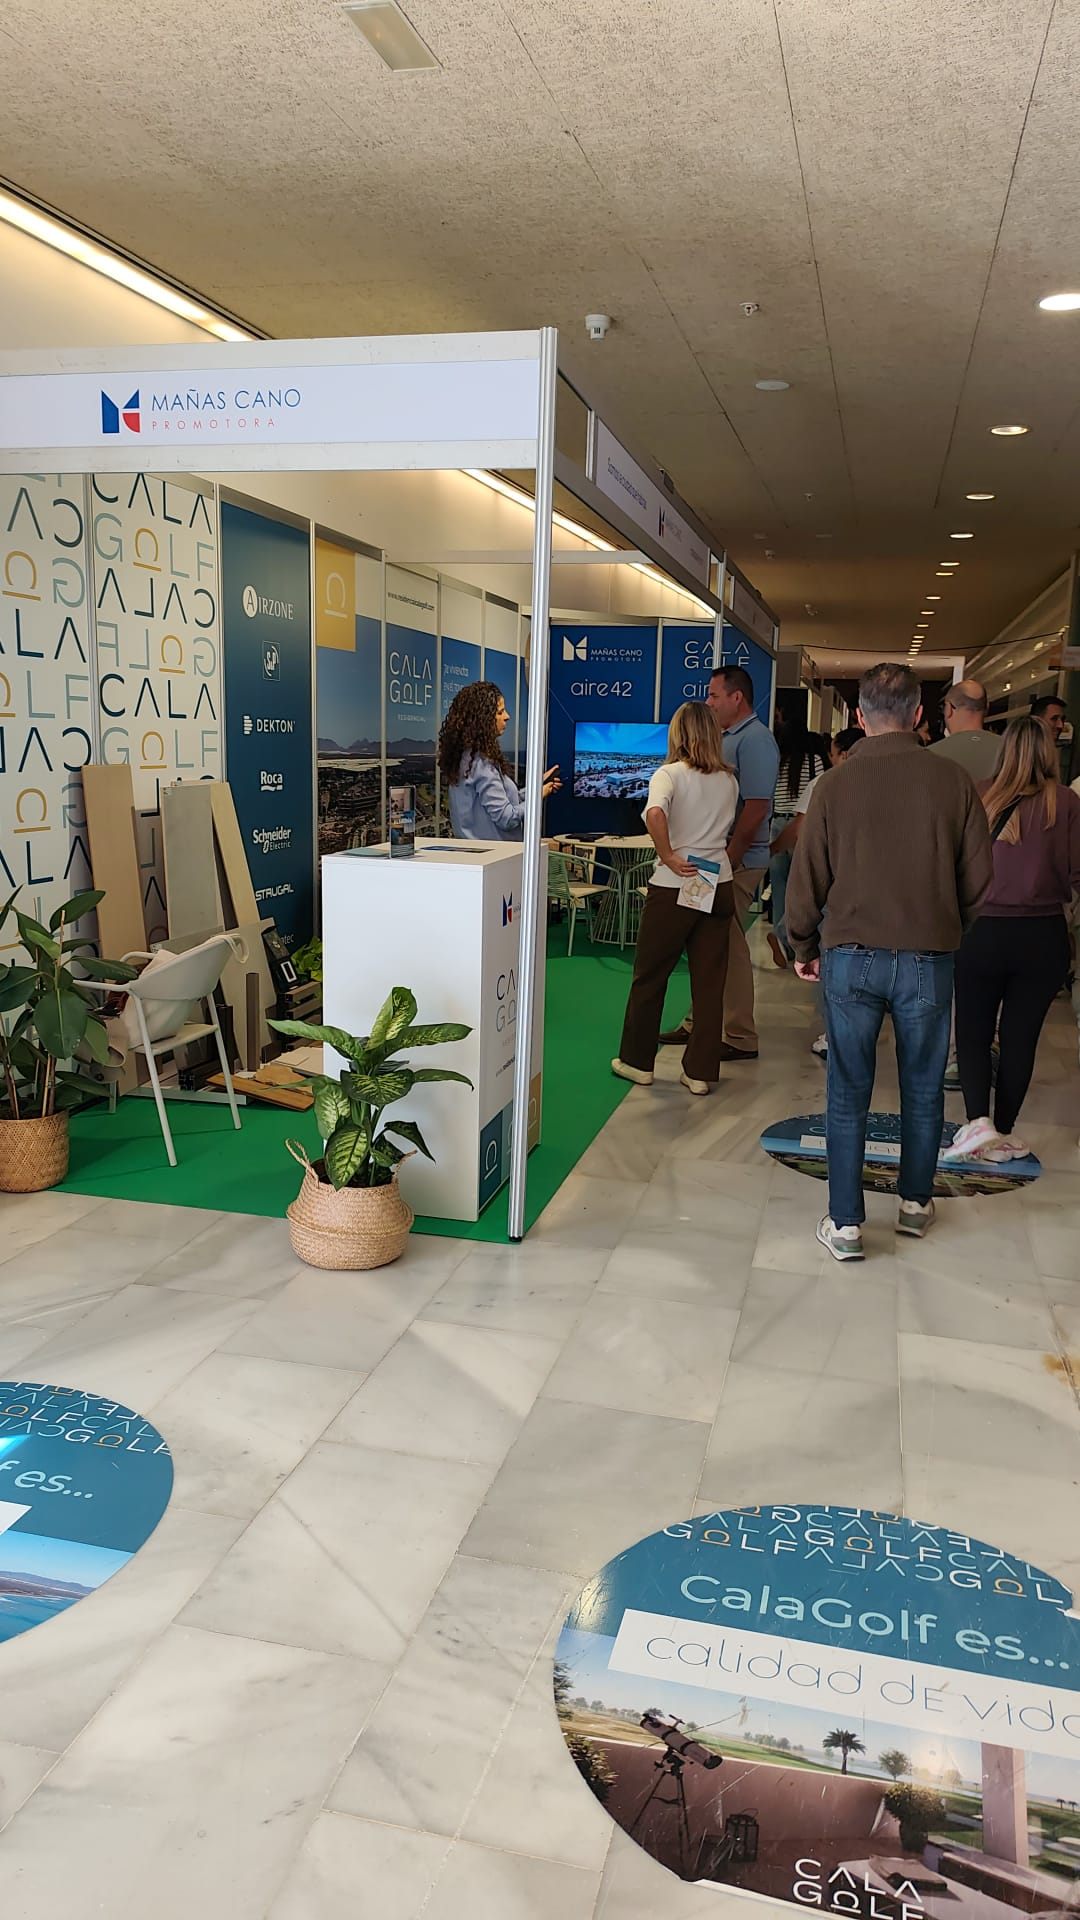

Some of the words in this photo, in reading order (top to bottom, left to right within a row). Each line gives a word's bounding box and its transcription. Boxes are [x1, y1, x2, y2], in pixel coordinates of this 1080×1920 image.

[151, 388, 226, 412] MAÑAS
[234, 388, 301, 409] CANO
[152, 417, 276, 431] PROMOTORA
[242, 585, 294, 620] AIRZONE
[389, 651, 432, 681] CALA
[590, 648, 617, 656] MAÑAS
[619, 649, 643, 657] CANO
[99, 673, 216, 721] CALA
[389, 679, 433, 707] GOLF
[256, 718, 294, 734] DEKTON
[101, 726, 218, 769] GOLF
[260, 770, 283, 785] Roca
[252, 826, 292, 844] Schneider
[269, 840, 292, 851] Electric
[14, 1470, 94, 1499] es...
[680, 1575, 938, 1645] CalaGolf
[955, 1628, 1071, 1671] es...
[645, 1637, 863, 1696] calidad
[794, 1858, 923, 1904] CALA
[792, 1880, 926, 1920] GOLF
